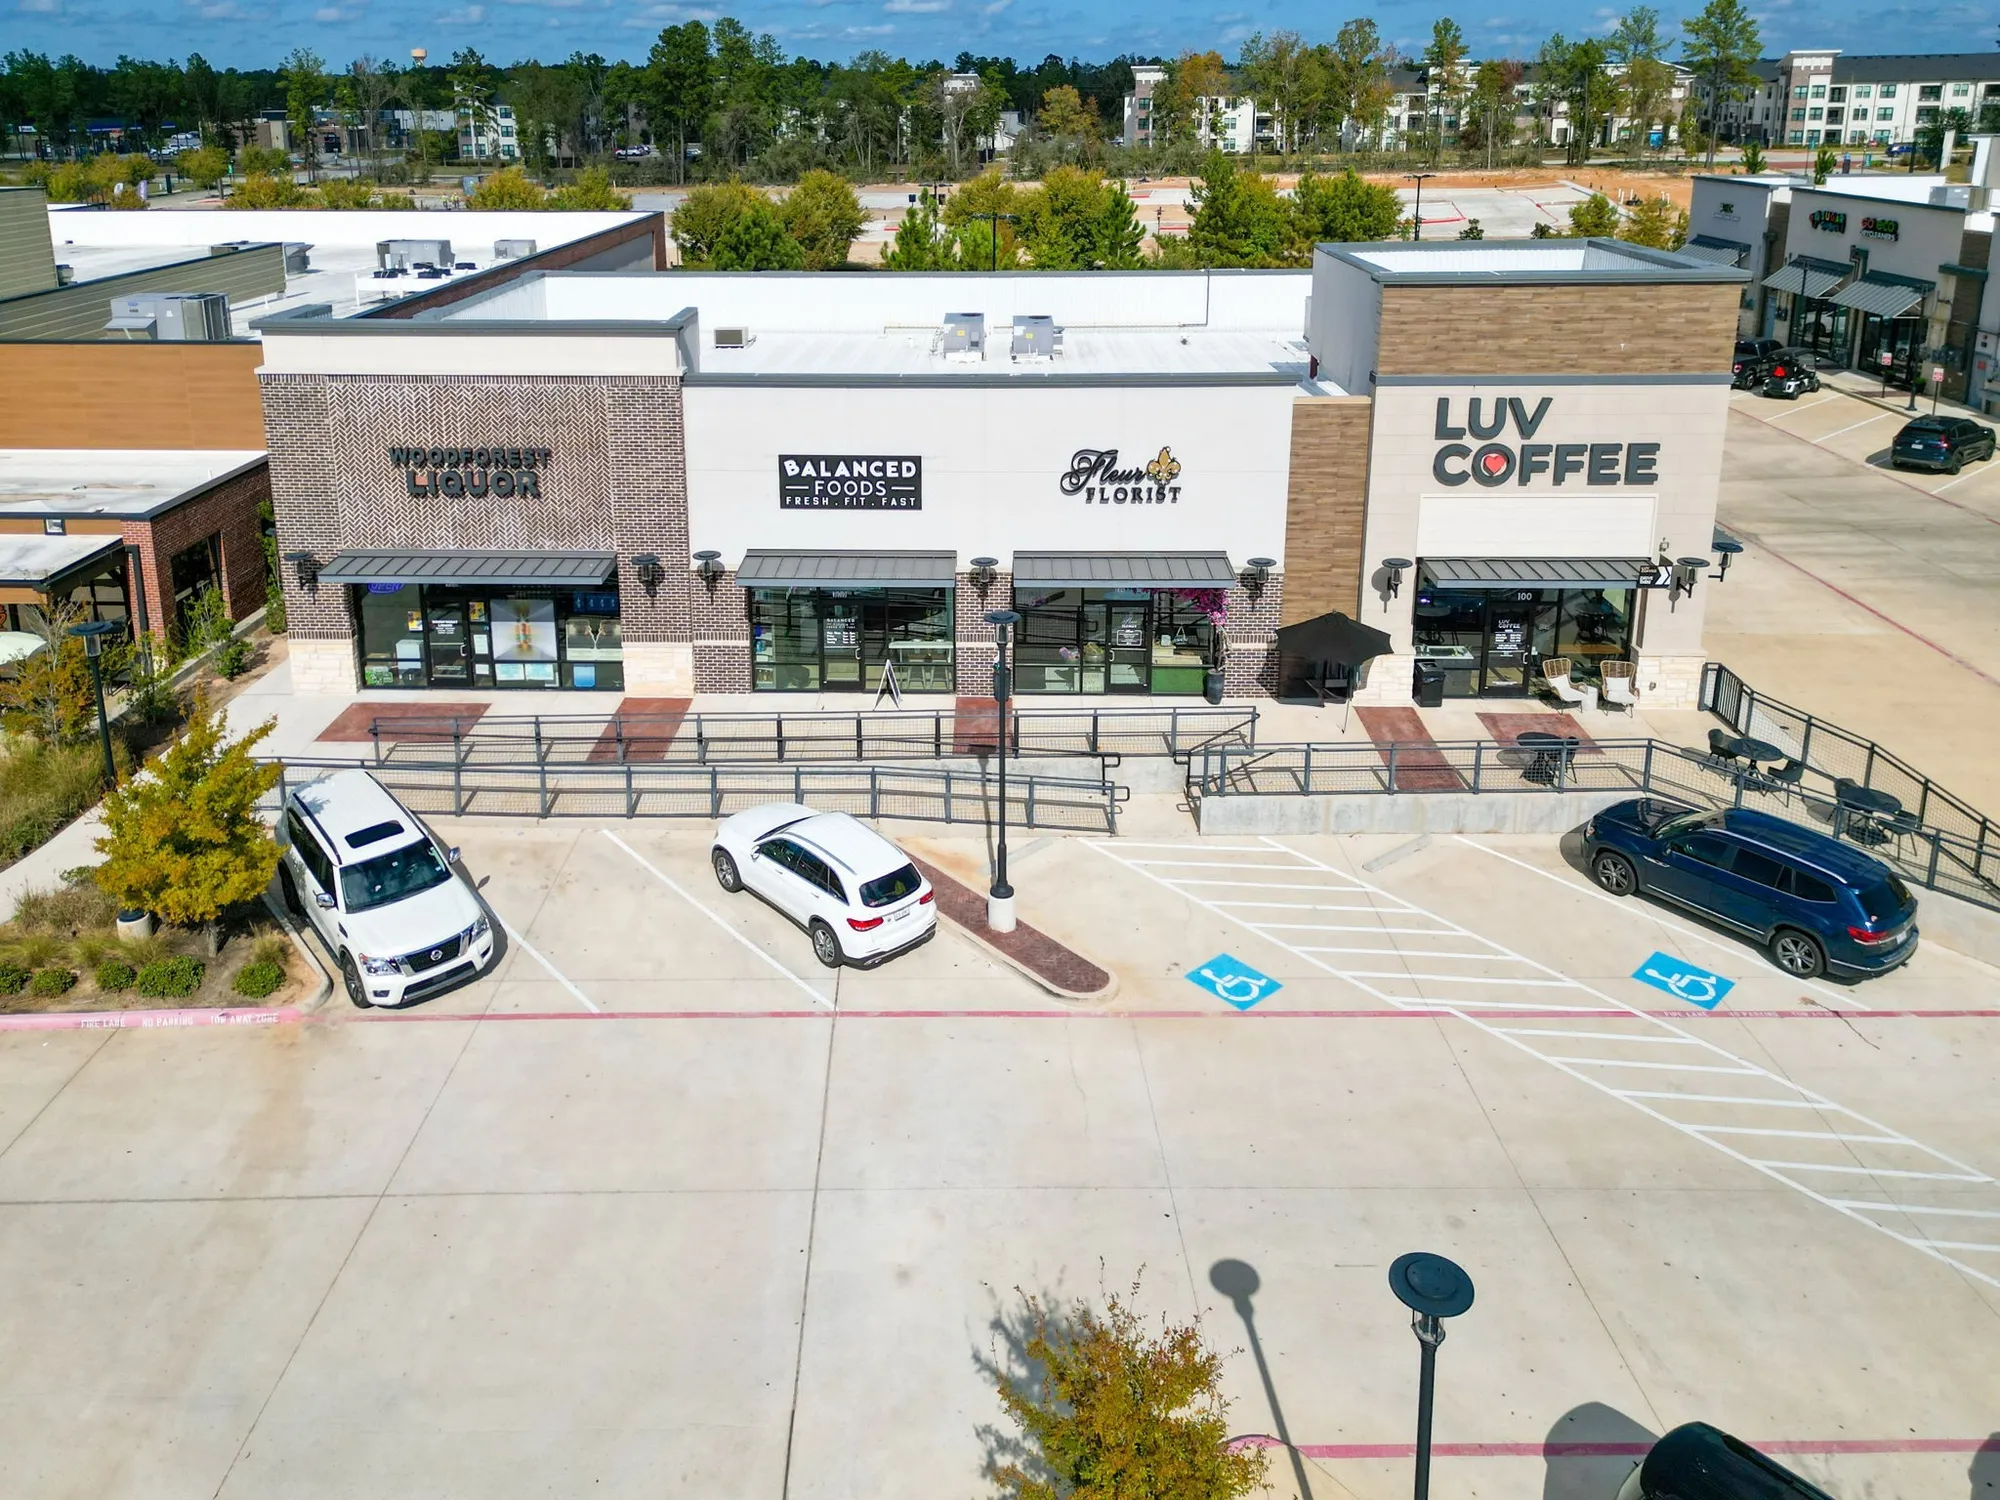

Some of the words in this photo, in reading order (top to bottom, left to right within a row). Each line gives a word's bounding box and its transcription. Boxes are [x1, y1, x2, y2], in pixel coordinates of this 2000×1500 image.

[1435, 397, 1553, 440] LUV
[388, 447, 550, 468] WOODFOREST
[1433, 443, 1660, 487] COFFEE
[783, 459, 917, 478] BALANCED
[1060, 449, 1147, 496] Fleur
[406, 470, 540, 499] LIQUOR
[814, 480, 887, 496] FOODS
[786, 496, 829, 506] FRESH
[844, 497, 866, 506] FIT
[881, 497, 916, 507] FAST
[1085, 486, 1181, 504] FLORIST
[1517, 592, 1533, 601] 100
[81, 1019, 101, 1028] FIRE
[103, 1018, 126, 1028] LANE
[142, 1016, 153, 1027] NO
[156, 1015, 194, 1027] PARKING
[210, 1015, 226, 1025] TOW
[230, 1014, 252, 1025] AWAY
[256, 1013, 280, 1024] ZONE
